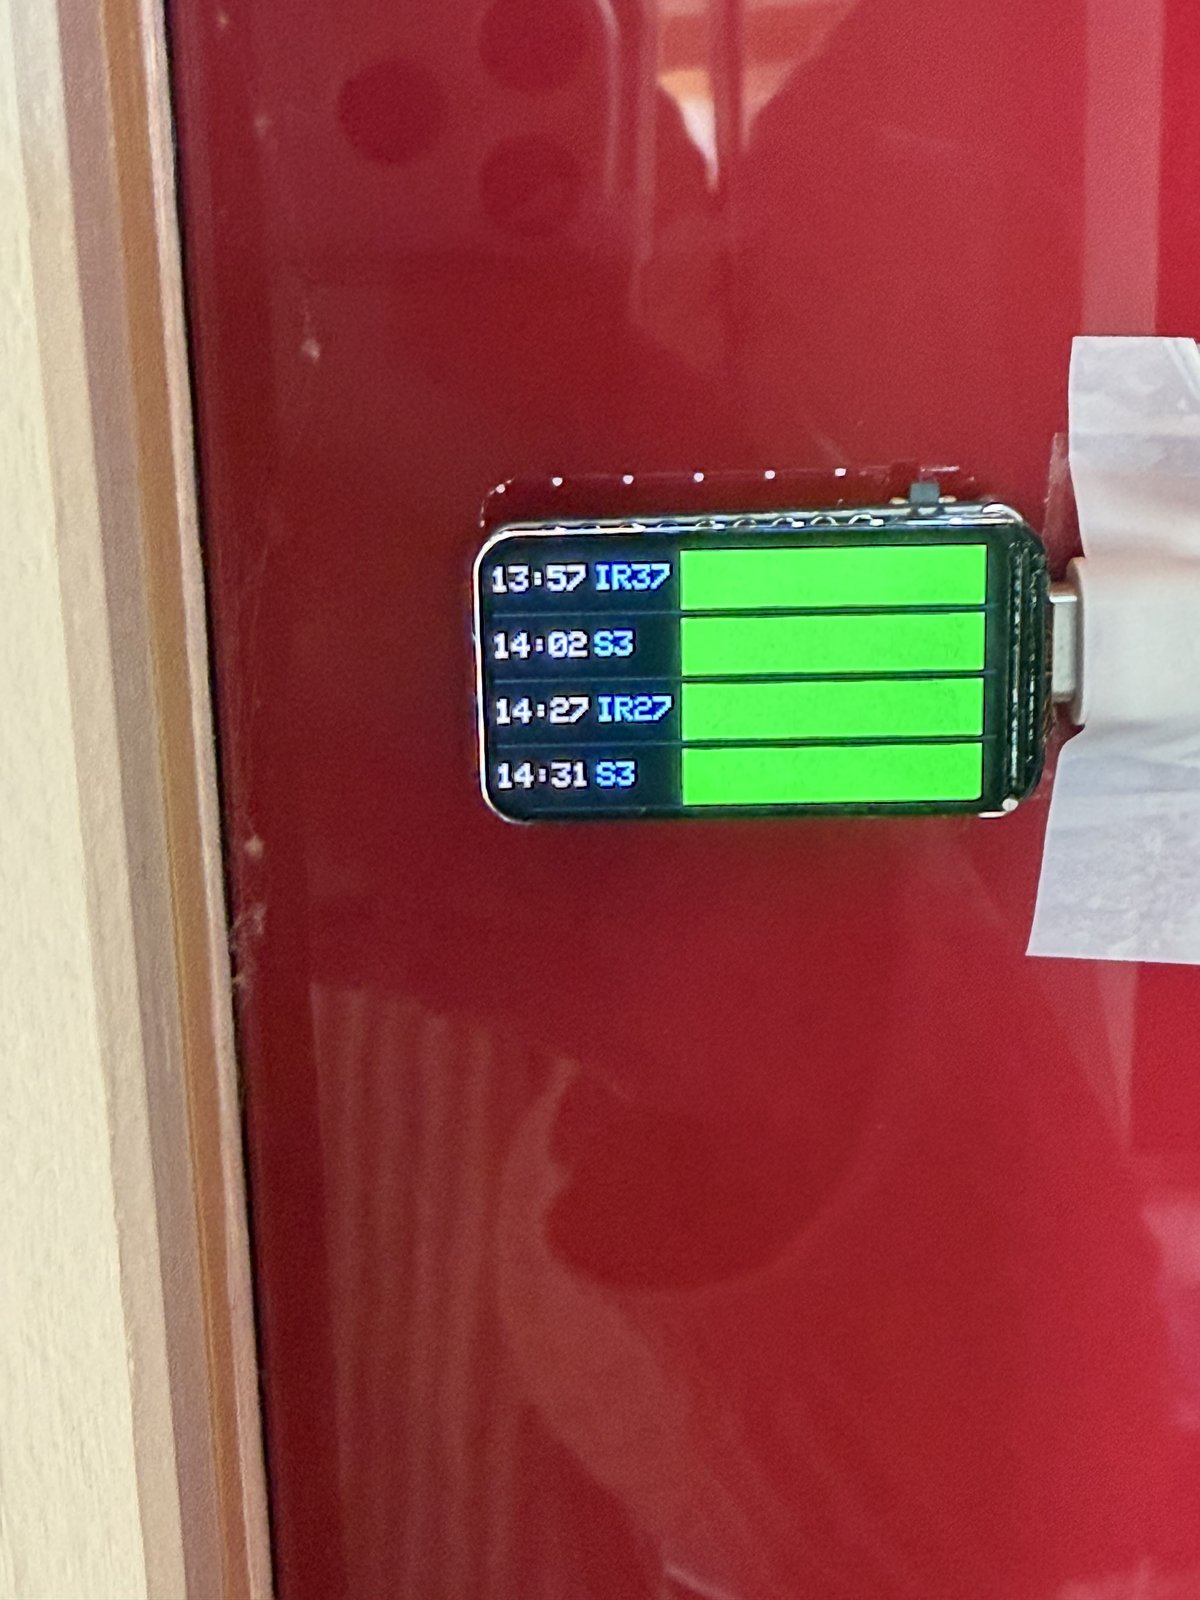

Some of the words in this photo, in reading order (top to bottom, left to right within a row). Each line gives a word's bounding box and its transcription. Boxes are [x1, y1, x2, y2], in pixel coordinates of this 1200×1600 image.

[491, 564, 587, 594] 13:57
[594, 562, 671, 593] IR37
[493, 631, 589, 660] 14:02
[594, 630, 634, 658] S3
[495, 696, 590, 725] 14:27
[597, 695, 673, 724] IR27
[497, 762, 588, 790] 14:31
[595, 760, 637, 789] S3
